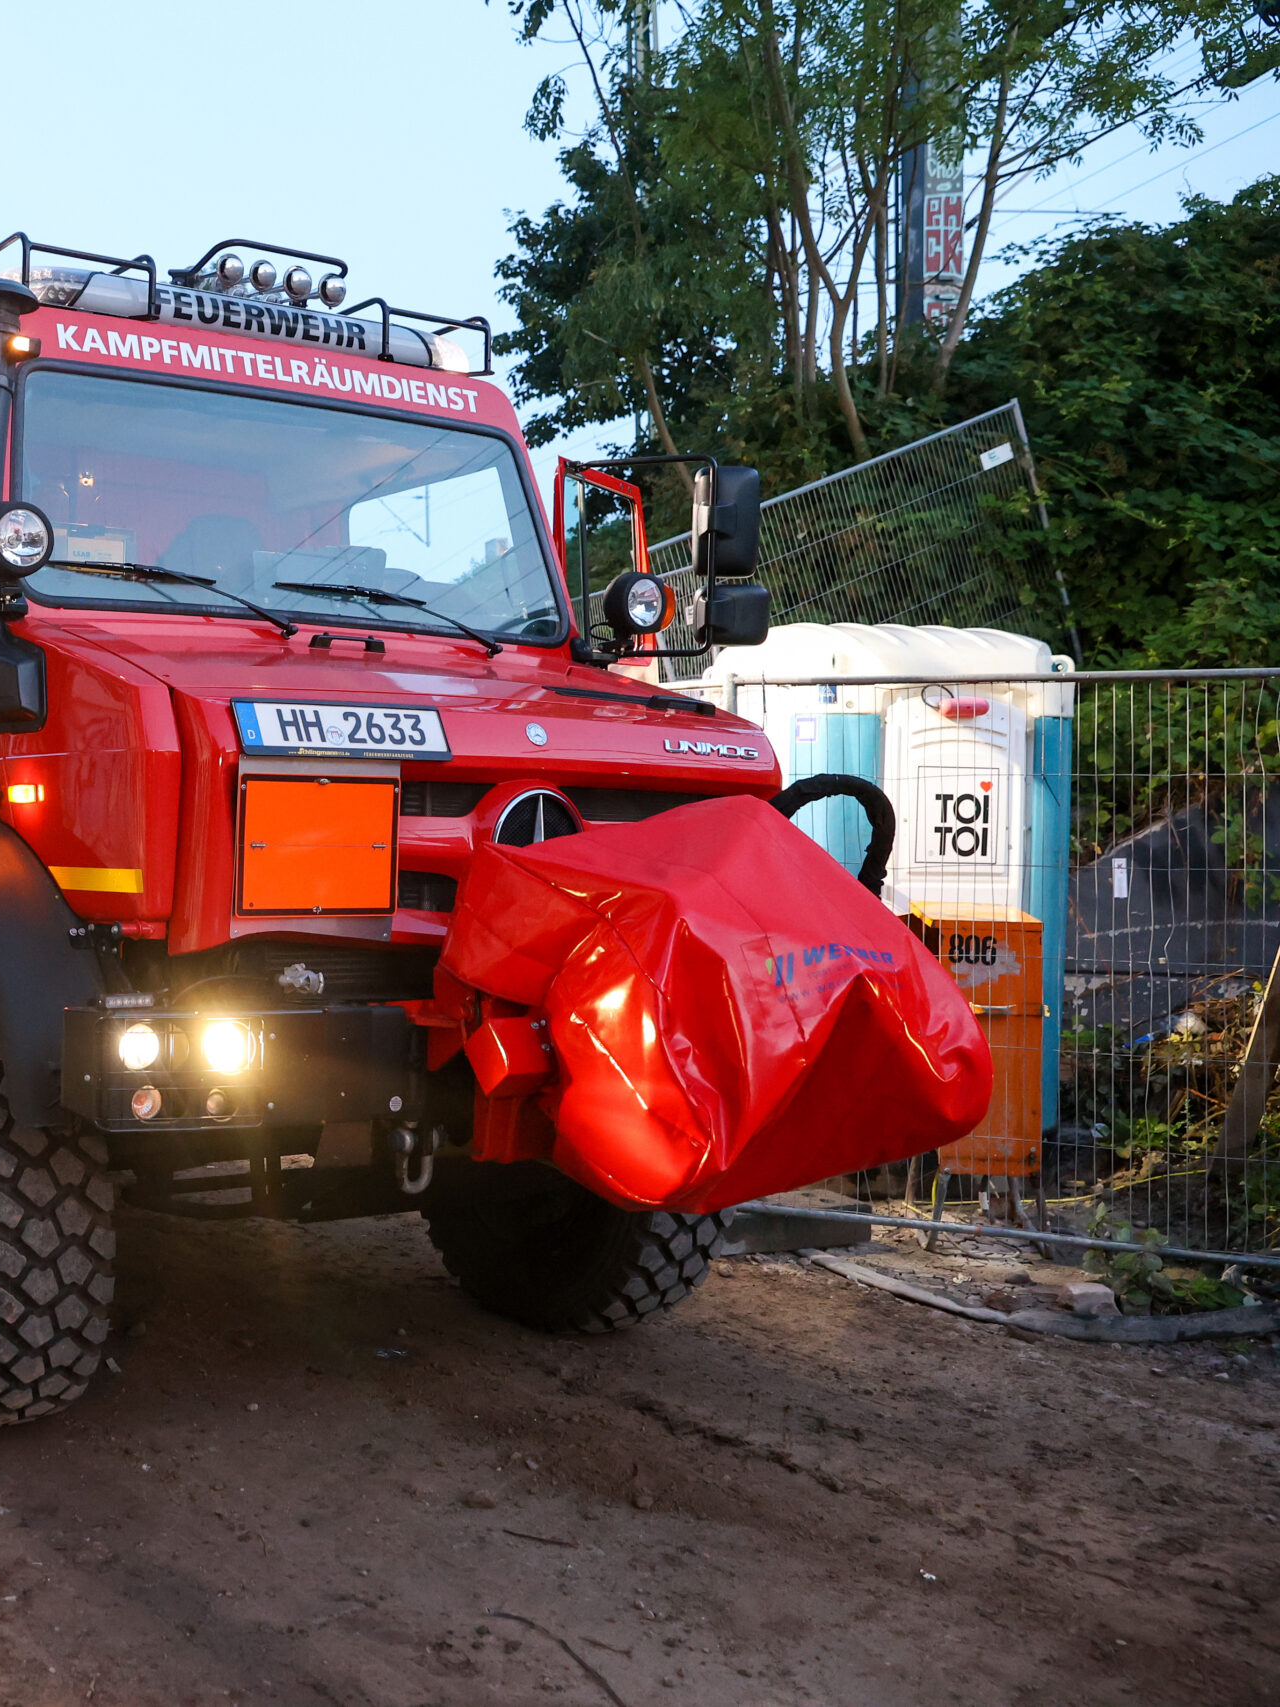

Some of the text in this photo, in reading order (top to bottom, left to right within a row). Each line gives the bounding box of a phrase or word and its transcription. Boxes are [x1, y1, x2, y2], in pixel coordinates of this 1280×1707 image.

[153, 288, 366, 350] FEUERWEHR
[56, 323, 478, 413] KAMPFMITTELRÄUMDIENST
[276, 708, 426, 746] HH 2633
[664, 739, 759, 760] UNIMOG
[935, 793, 990, 825] TOI
[934, 826, 988, 857] TOI
[948, 933, 998, 967] 806
